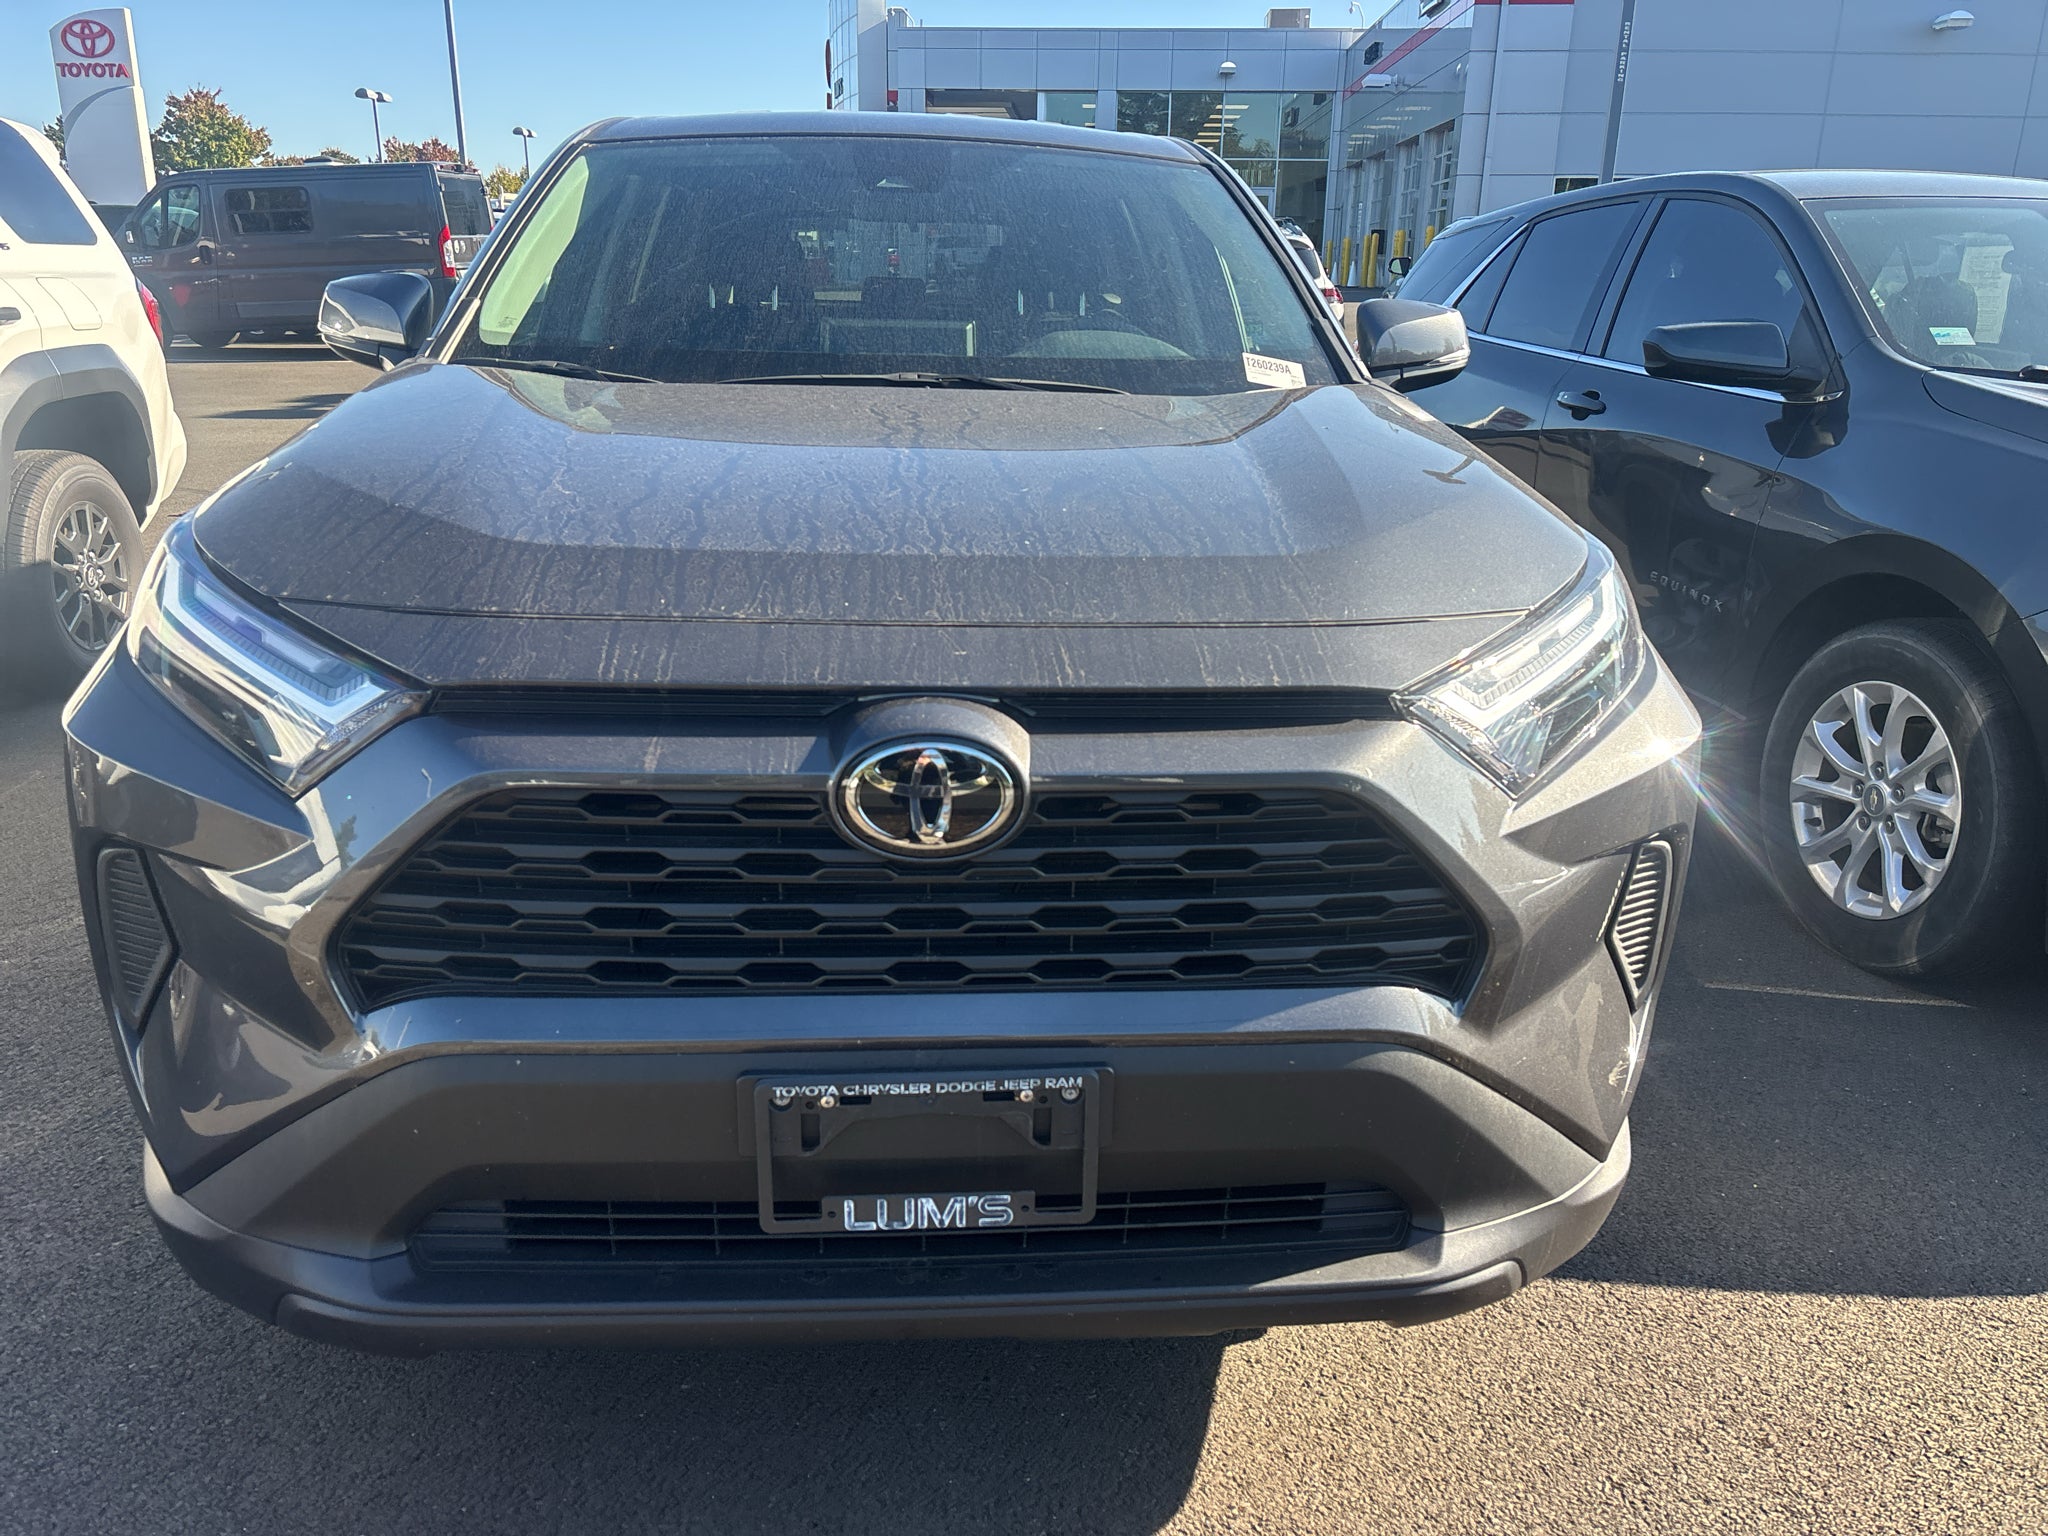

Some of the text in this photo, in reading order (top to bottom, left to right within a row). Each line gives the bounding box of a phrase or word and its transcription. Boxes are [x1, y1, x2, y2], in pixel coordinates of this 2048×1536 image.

[1617, 21, 1631, 82] RENTAL PARKING
[55, 62, 130, 78] TOYOTA
[1245, 356, 1292, 375] T260239A
[1650, 570, 1723, 613] EQUINOX
[772, 1076, 1083, 1097] TOYOTA CHRYSLER DODGE JEEP RAM
[843, 1194, 1014, 1231] LUM'S
